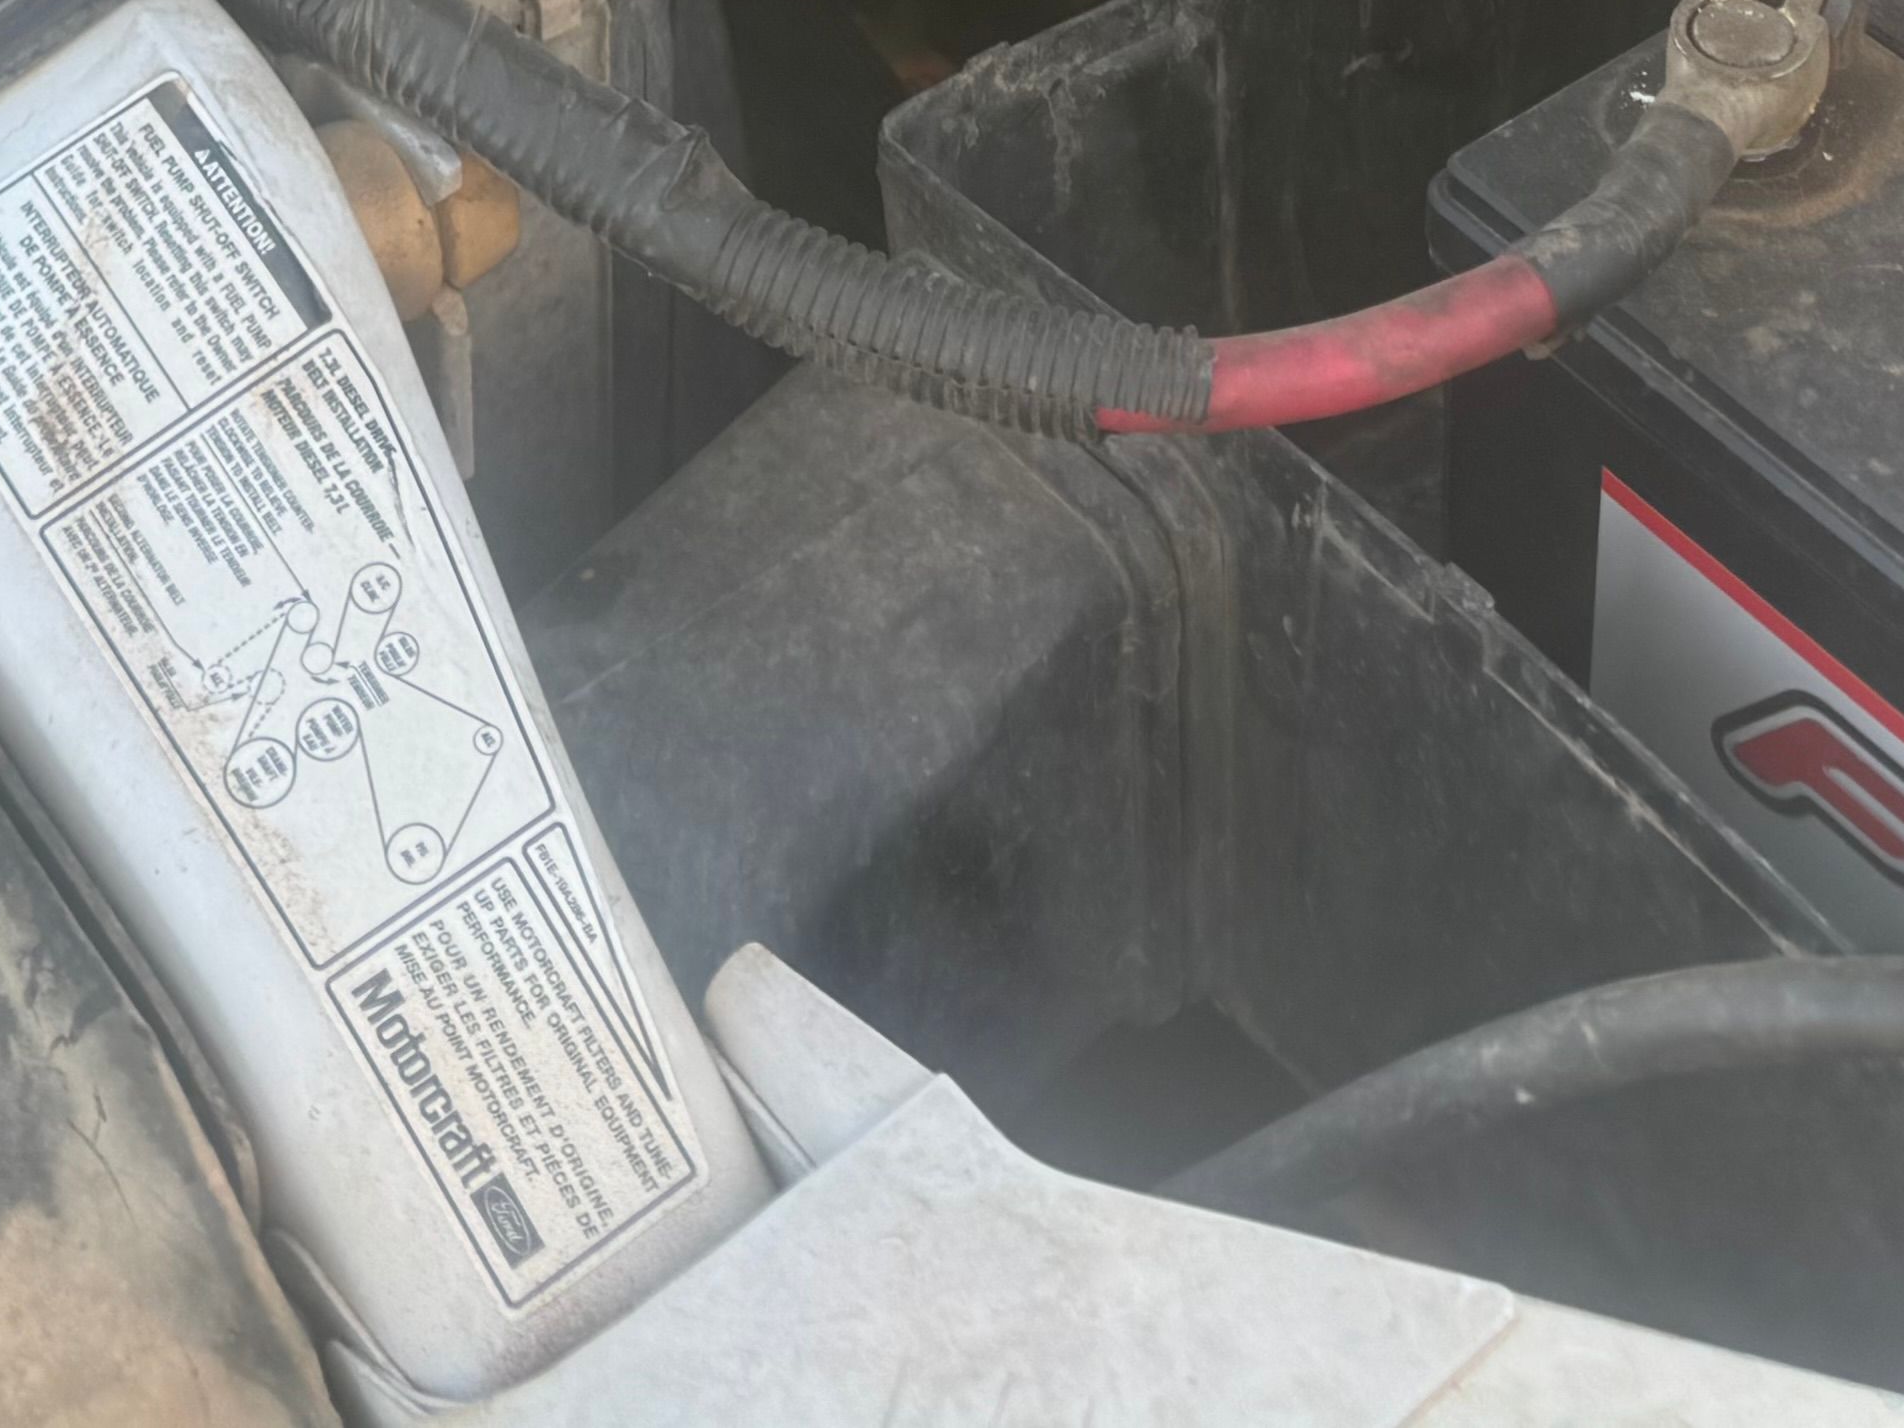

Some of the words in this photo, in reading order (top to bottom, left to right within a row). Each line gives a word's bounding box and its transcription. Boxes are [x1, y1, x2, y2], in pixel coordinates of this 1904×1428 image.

[60, 153, 89, 187] Guide
[84, 189, 104, 210] for
[99, 211, 135, 256] switch
[131, 259, 173, 312] location
[169, 316, 194, 344] and
[190, 348, 222, 386] reset
[92, 131, 132, 179] SHUT-OFF
[152, 220, 195, 273] Resetting
[186, 271, 211, 297] this
[202, 294, 237, 337] switch
[229, 334, 256, 364] may
[99, 176, 119, 196] the
[140, 237, 172, 276] Please
[164, 272, 191, 304] refer
[182, 300, 199, 316] to
[191, 313, 213, 337] the
[204, 333, 239, 375] Owner
[109, 120, 132, 145] This
[158, 192, 200, 245] equipped
[192, 243, 218, 272] with
[219, 282, 247, 315] FUEL
[240, 313, 272, 352] PUMP
[138, 121, 169, 157] FUEL
[160, 154, 195, 196] PUMP
[187, 193, 241, 263] SHUT-OFF
[232, 260, 280, 321] SWITCH
[201, 157, 277, 256] ATTENTION!
[7, 298, 27, 319] DE
[19, 317, 55, 363] POMPE
[11, 269, 33, 291] est
[24, 288, 58, 330] équipé
[68, 355, 134, 446] INTERRUPTEUR
[18, 234, 40, 257] DE
[31, 254, 72, 306] POMPE
[72, 316, 125, 387] ESSENCE
[19, 200, 93, 301] INTERRUPTEUR
[84, 297, 160, 404] AUTOMATIQUE
[317, 347, 344, 377] 7.3L
[335, 375, 371, 419] DIESEL
[1, 403, 56, 477] interrupteur
[47, 474, 66, 493] et
[10, 340, 32, 365] cet
[24, 363, 79, 438] interrupteur
[72, 437, 100, 470] peut
[249, 466, 264, 481] TO
[259, 388, 303, 441] MOTEUR
[293, 438, 331, 483] DIESEL
[276, 377, 328, 443] PARCOURS
[318, 440, 341, 462] DE
[331, 459, 353, 480] LA
[343, 477, 394, 542] COURROIE
[301, 358, 329, 390] BELT
[320, 388, 384, 474] INSTALLATION
[201, 491, 217, 507] LA
[220, 493, 235, 508] LA
[429, 916, 468, 972] POUR
[461, 972, 487, 1005] UN
[480, 1005, 555, 1121] RENDEMENT
[455, 898, 539, 1030] PERFORMANCE.
[473, 886, 497, 914] UP
[489, 914, 531, 973] PARTS
[522, 972, 553, 1011] FOR
[543, 1010, 600, 1094] ORIGINAL
[591, 1094, 658, 1196] EQUIPMENT
[490, 874, 520, 912] USE
[510, 909, 586, 1027] MOTORCRAFT
[575, 1024, 623, 1092] FILTERS
[613, 1090, 644, 1130] AND
[635, 1129, 676, 1184] TUNE-
[349, 967, 502, 1189] Motorcraft
[393, 940, 428, 987] MISE
[418, 983, 442, 1012] AU
[433, 1010, 472, 1063] POINT
[463, 1062, 542, 1183] MOTORCRAFT.
[411, 928, 459, 998] EXIGER
[451, 998, 481, 1036] LES
[474, 1037, 524, 1111] FILTRES
[518, 1113, 540, 1139] ET
[574, 1211, 599, 1240] DE
[488, 1194, 532, 1246] Ford
